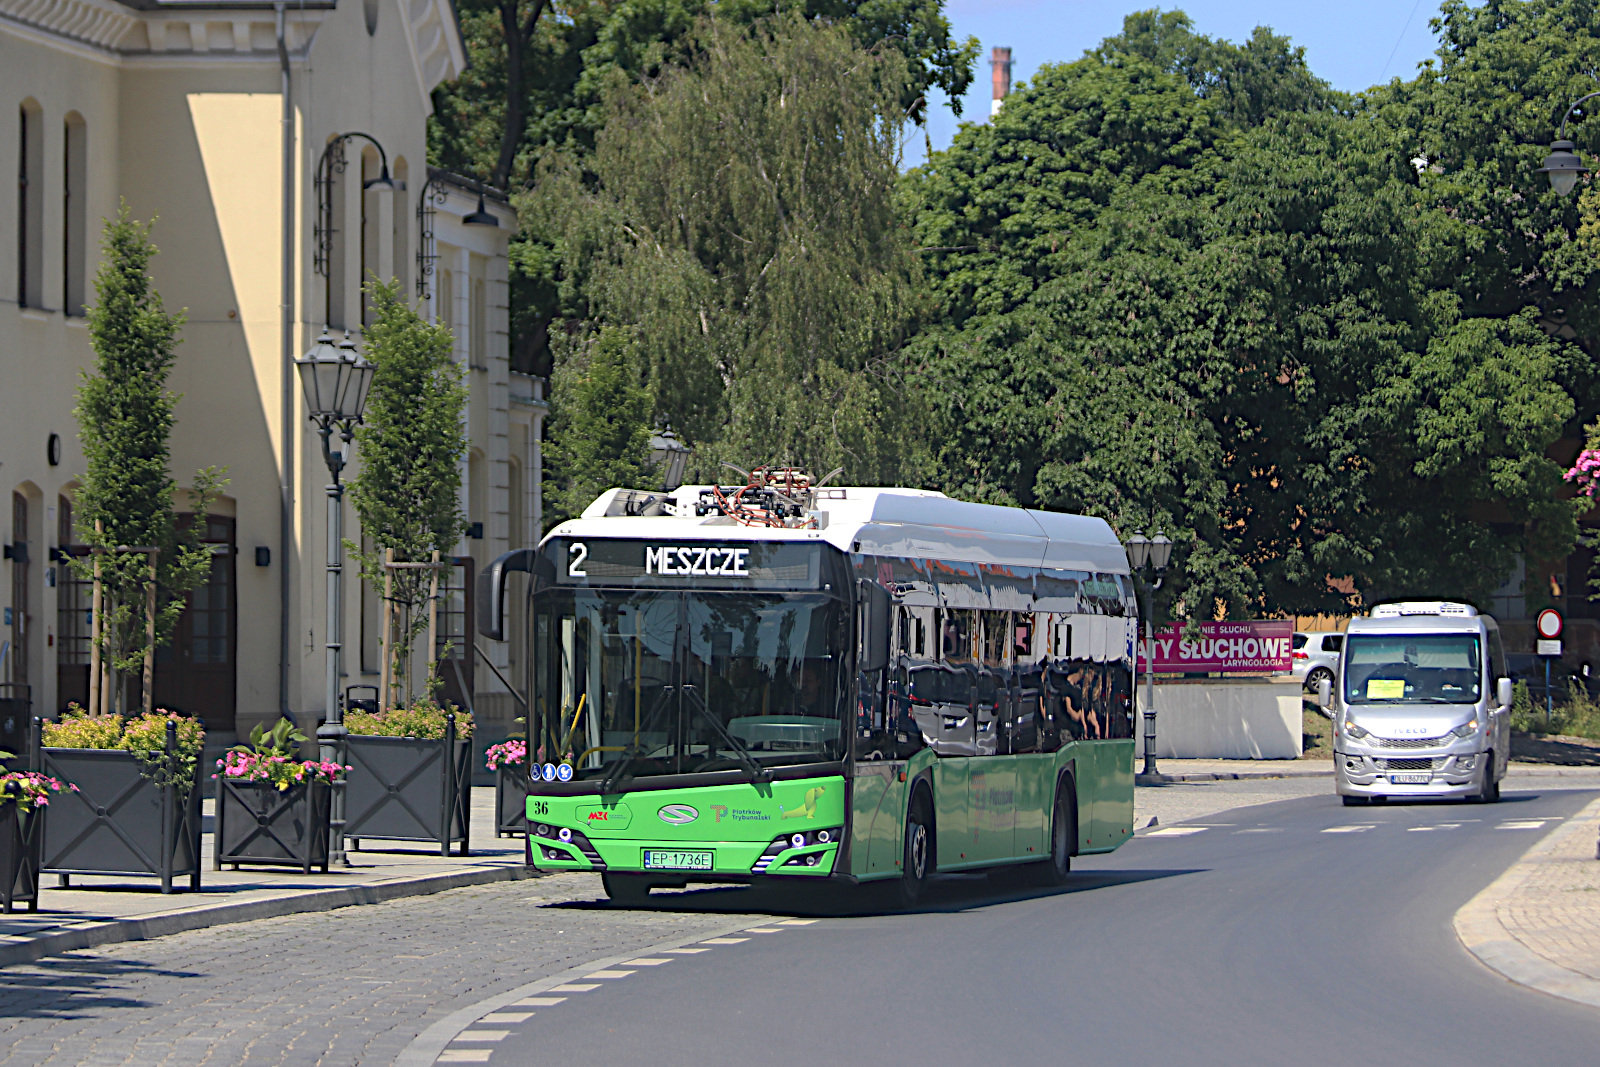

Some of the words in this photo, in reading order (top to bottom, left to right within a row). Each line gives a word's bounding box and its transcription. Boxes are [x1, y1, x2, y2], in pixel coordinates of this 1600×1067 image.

[569, 542, 588, 577] 2
[646, 546, 749, 576] MESZCZE
[1219, 625, 1251, 634] SŁUCHU
[1179, 637, 1290, 659] SŁUCHOWE
[1222, 658, 1284, 667] LARYNGOLOGIA
[534, 800, 549, 815] 36
[652, 853, 668, 864] EP
[673, 854, 709, 865] 1736E
